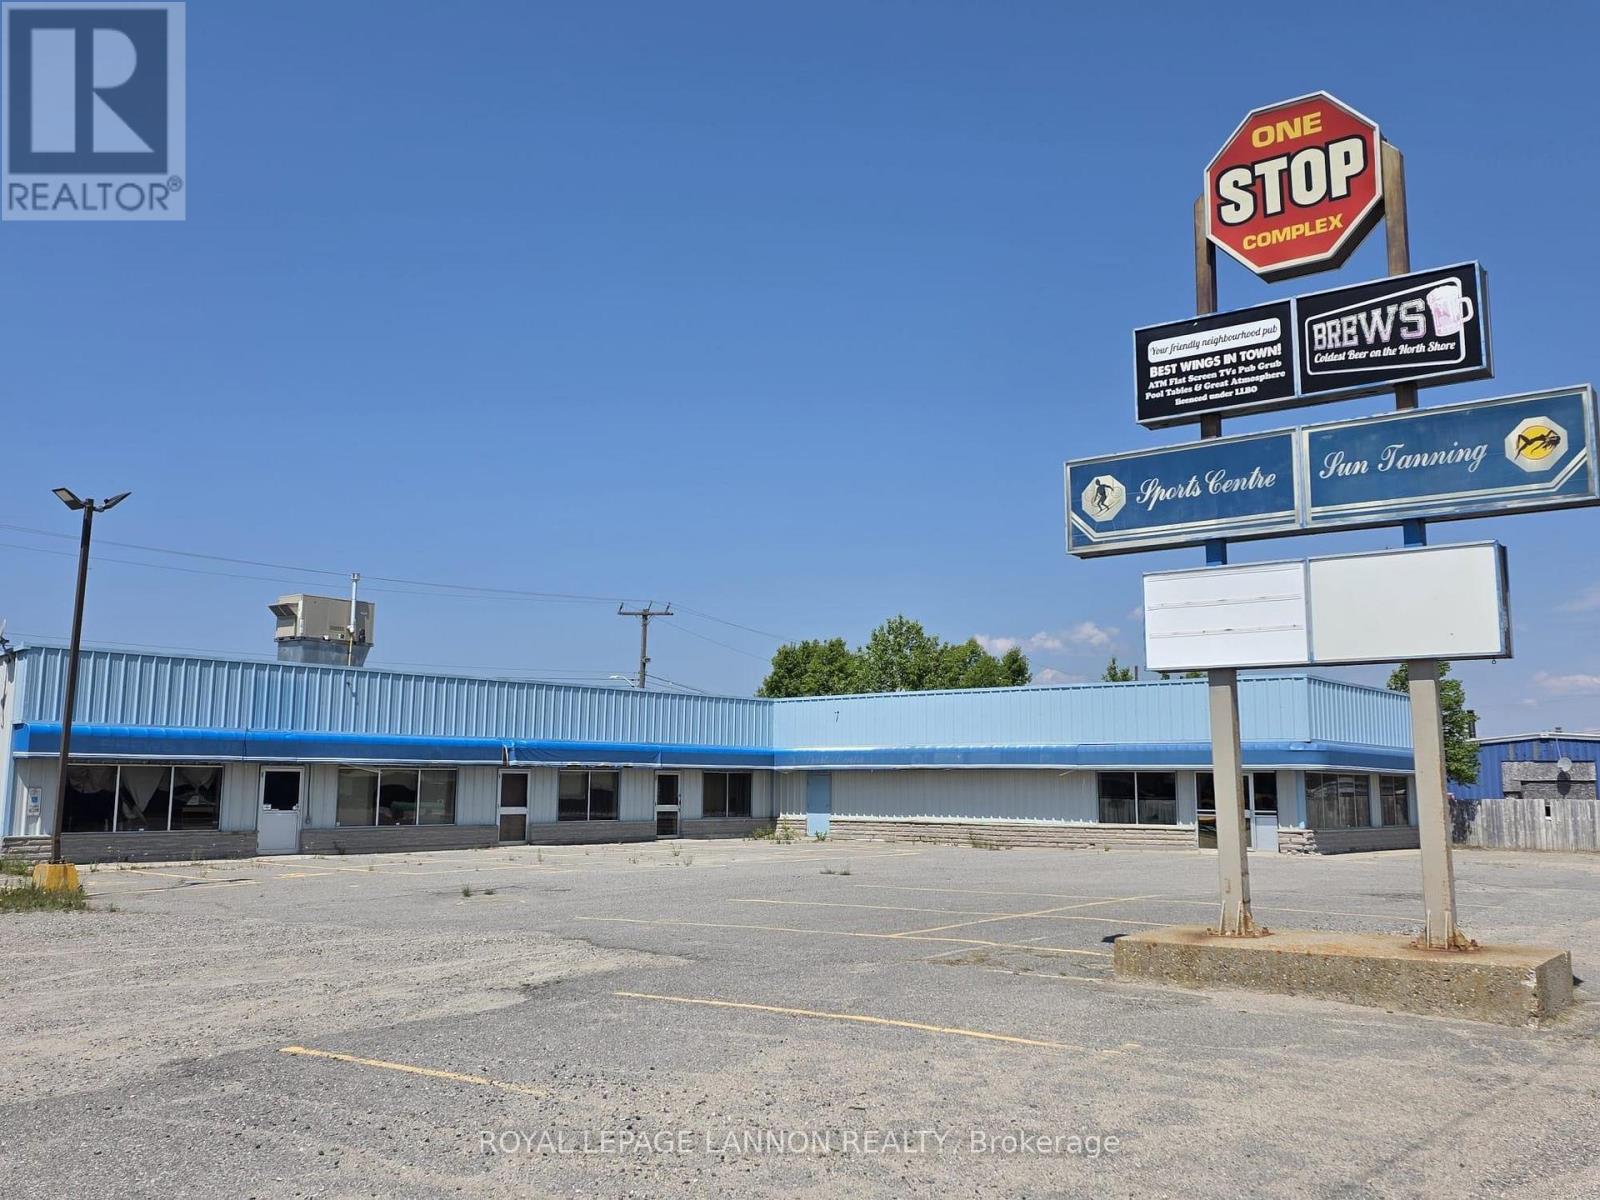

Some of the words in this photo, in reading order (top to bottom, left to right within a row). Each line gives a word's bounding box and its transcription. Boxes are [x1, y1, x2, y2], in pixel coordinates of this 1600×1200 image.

[1251, 111, 1323, 148] ONE
[1216, 135, 1367, 227] STOP
[1242, 213, 1344, 250] COMPLEX
[1151, 345, 1168, 356] Your
[1168, 340, 1200, 355] friendly
[1201, 328, 1261, 347] neighbourhood
[1262, 325, 1278, 337] pub
[1312, 298, 1427, 351] BREWS
[1149, 363, 1177, 378] BEST
[1180, 355, 1221, 373] WINGS
[1223, 353, 1238, 365] IN
[1239, 343, 1282, 362] TOWN!
[1314, 350, 1346, 364] Coldest
[1347, 349, 1369, 361] Beer
[1382, 346, 1396, 357] the
[1398, 342, 1426, 355] North
[1427, 341, 1456, 353] Shore
[1145, 391, 1164, 400] Pool
[1165, 385, 1193, 397] Tables
[1194, 383, 1203, 392] &
[1203, 379, 1229, 390] Great
[1230, 370, 1286, 386] Atmosphere
[1148, 379, 1168, 390] ATM
[1168, 377, 1187, 387] Flat
[1187, 372, 1218, 383] Screen
[1218, 368, 1237, 378] TVs
[1238, 364, 1256, 374] Pub
[1257, 360, 1282, 371] Grub
[1208, 390, 1233, 400] under
[1318, 450, 1369, 479] Sun
[1377, 441, 1489, 473] Tanning
[1135, 474, 1202, 512] Sports
[1204, 466, 1277, 495] Centre
